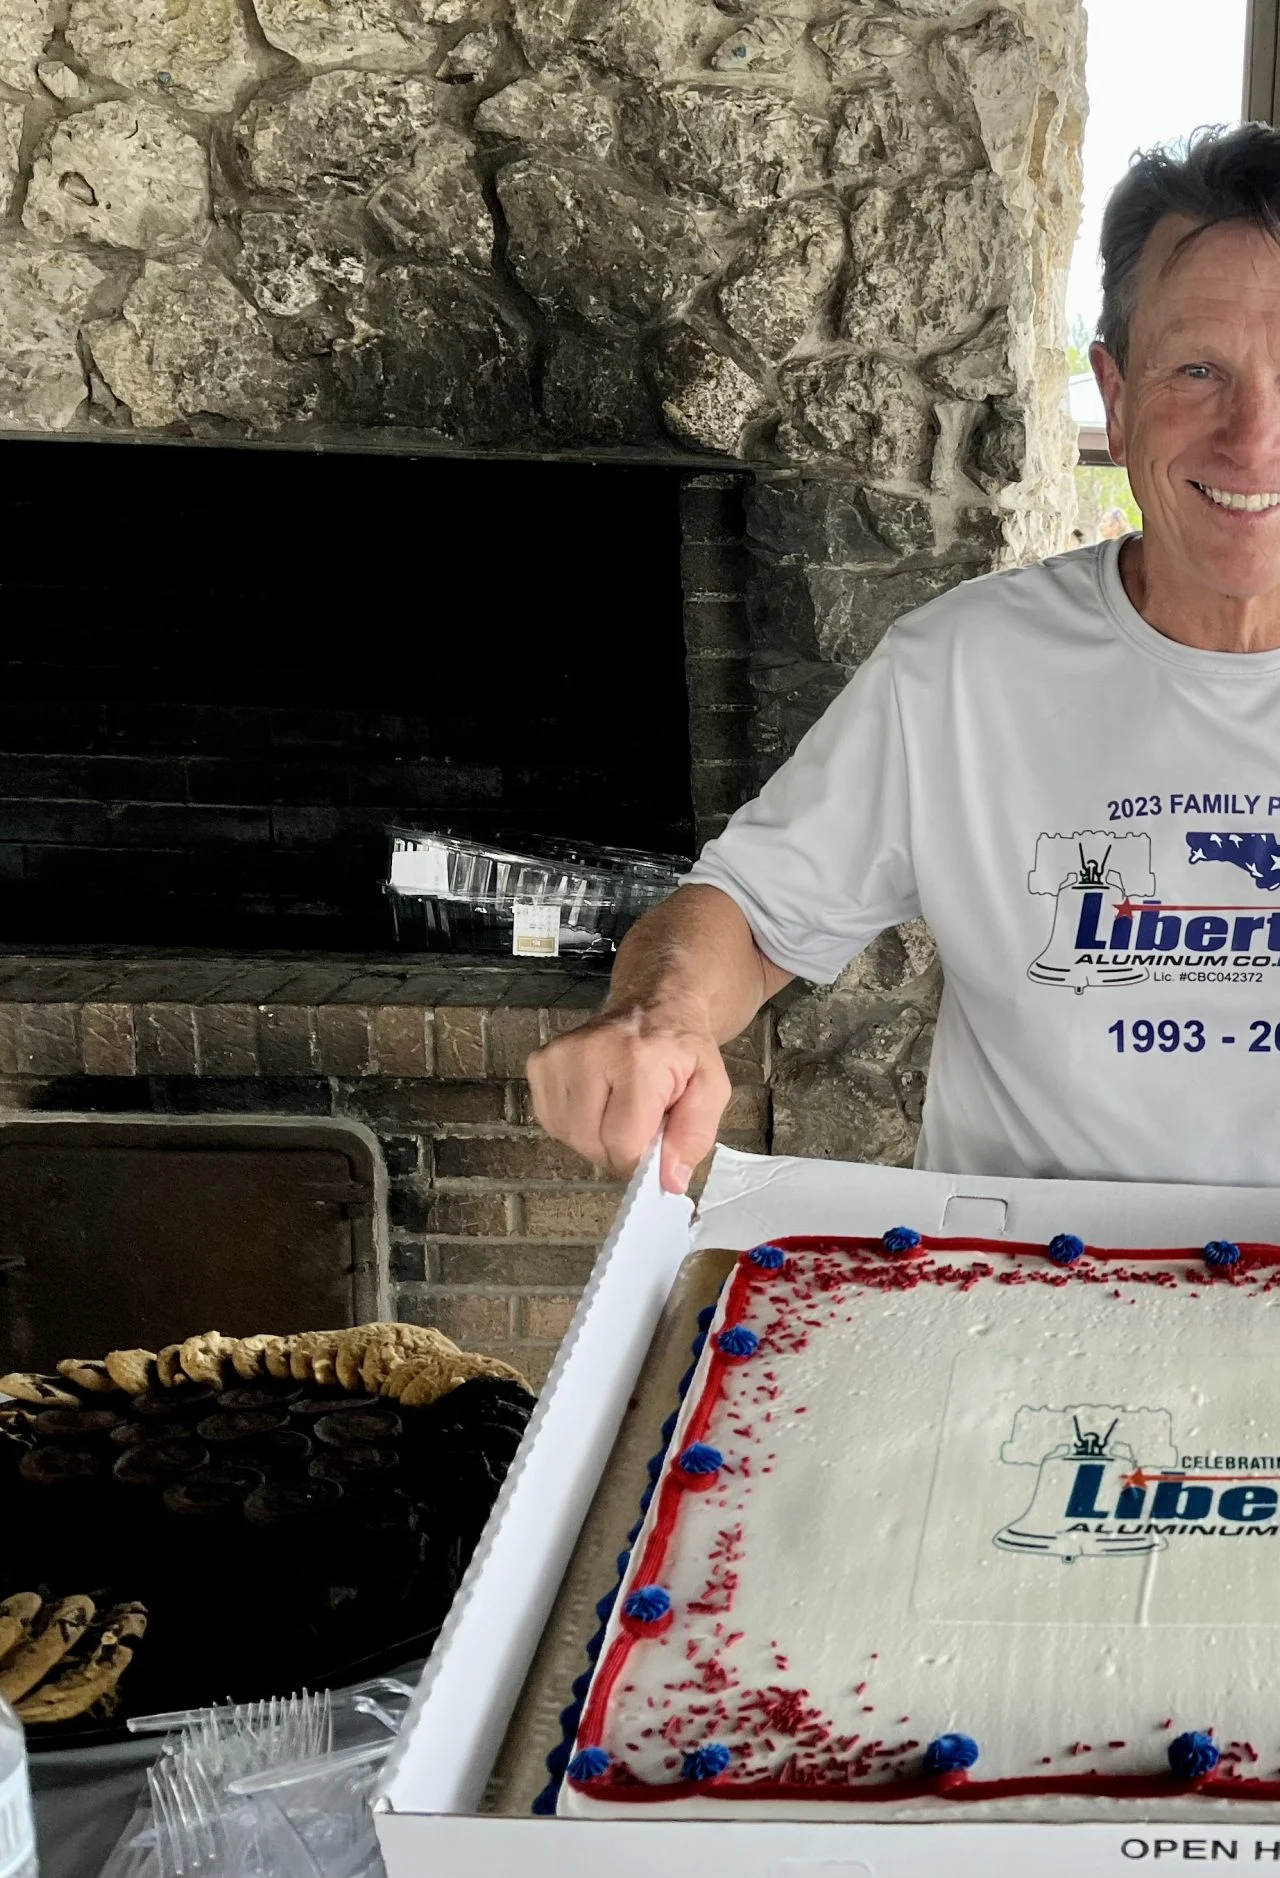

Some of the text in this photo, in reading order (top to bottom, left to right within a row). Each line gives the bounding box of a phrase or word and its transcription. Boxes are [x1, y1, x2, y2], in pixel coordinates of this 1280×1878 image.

[1107, 796, 1163, 821] 2023
[1170, 794, 1261, 815] FAMILY
[1074, 954, 1278, 967] ALUMINUM CO.
[1153, 971, 1263, 982] Lic. #CBC042372
[1107, 1019, 1206, 1053] 1993
[1120, 1838, 1239, 1860] OPEN
